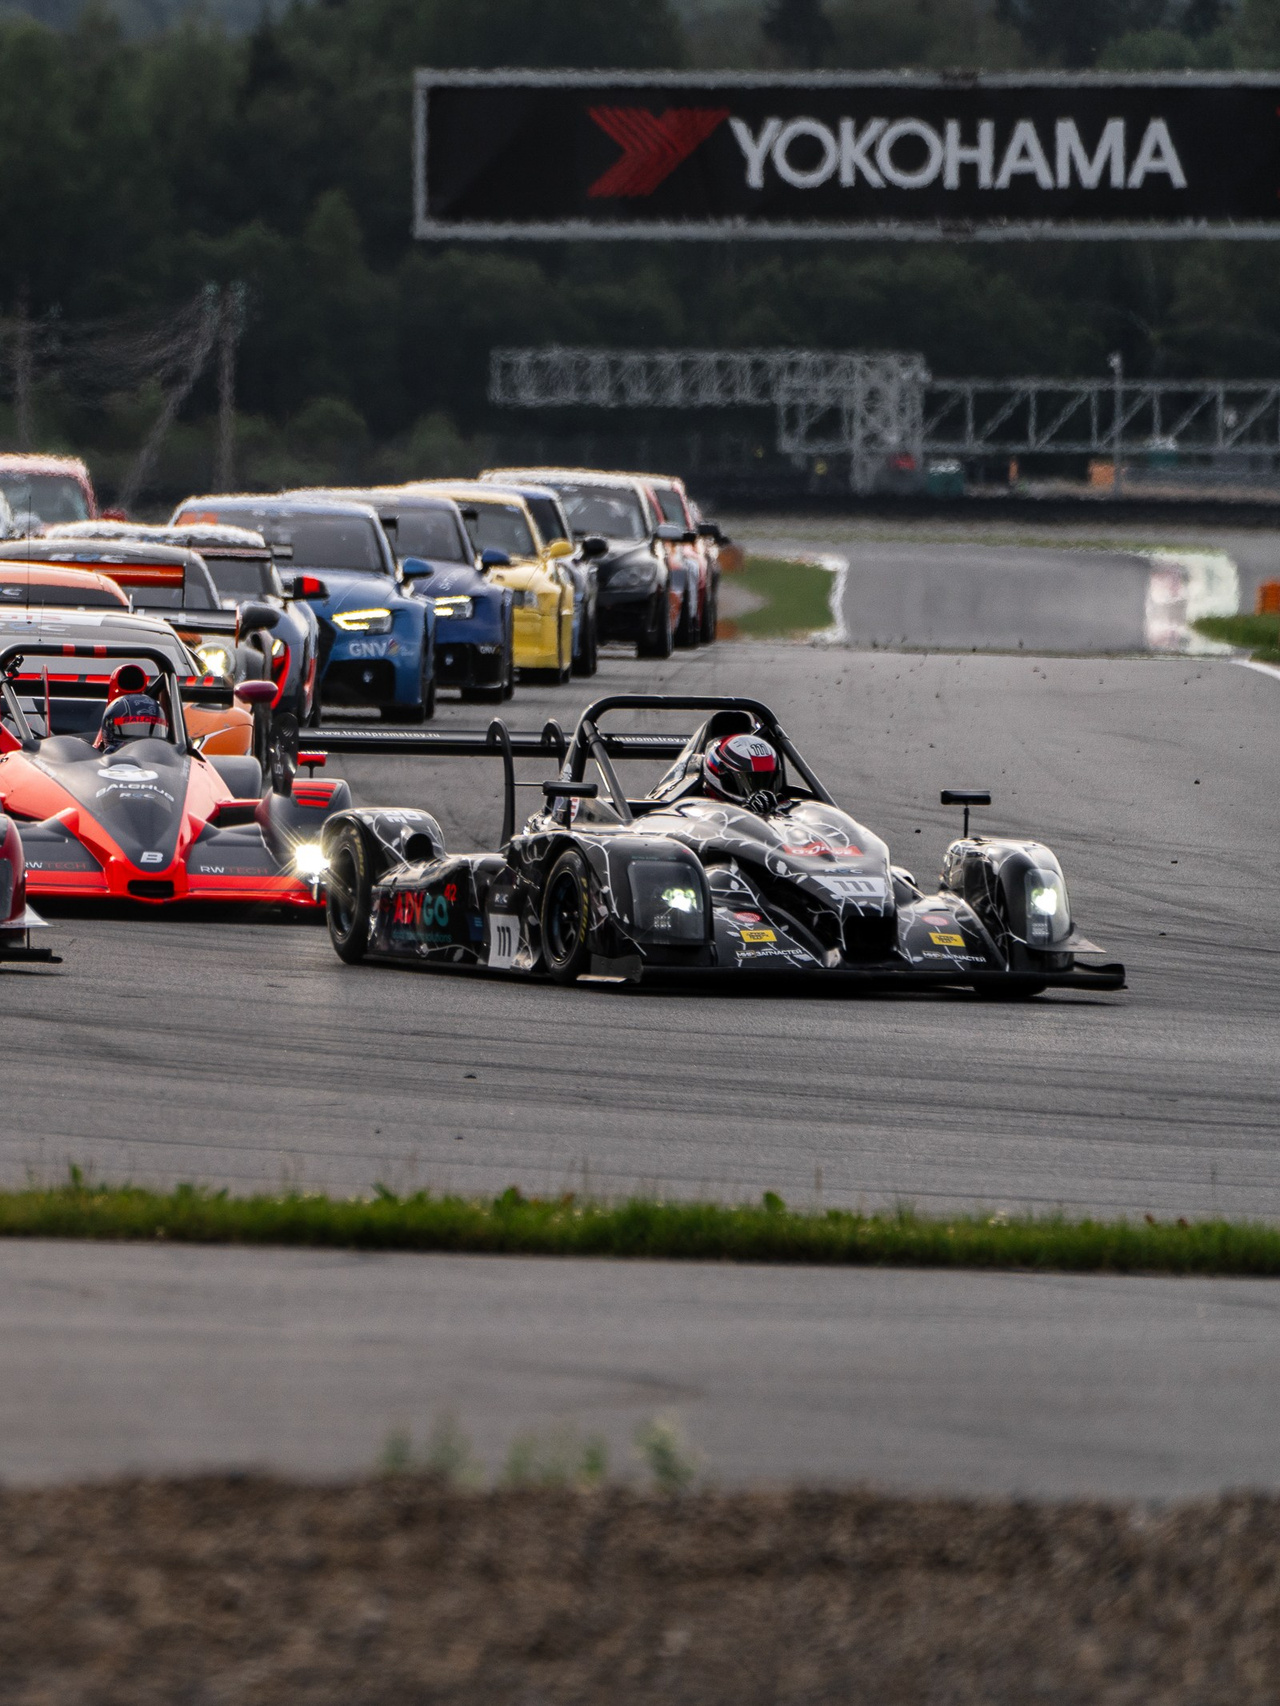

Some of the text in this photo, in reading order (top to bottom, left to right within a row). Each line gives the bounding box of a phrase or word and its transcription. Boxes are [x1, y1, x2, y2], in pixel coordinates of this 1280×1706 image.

[729, 117, 1187, 190] YOKOHAMA
[349, 641, 387, 657] GNV
[140, 851, 163, 863] B
[833, 881, 876, 892] 111
[496, 926, 512, 957] 111
